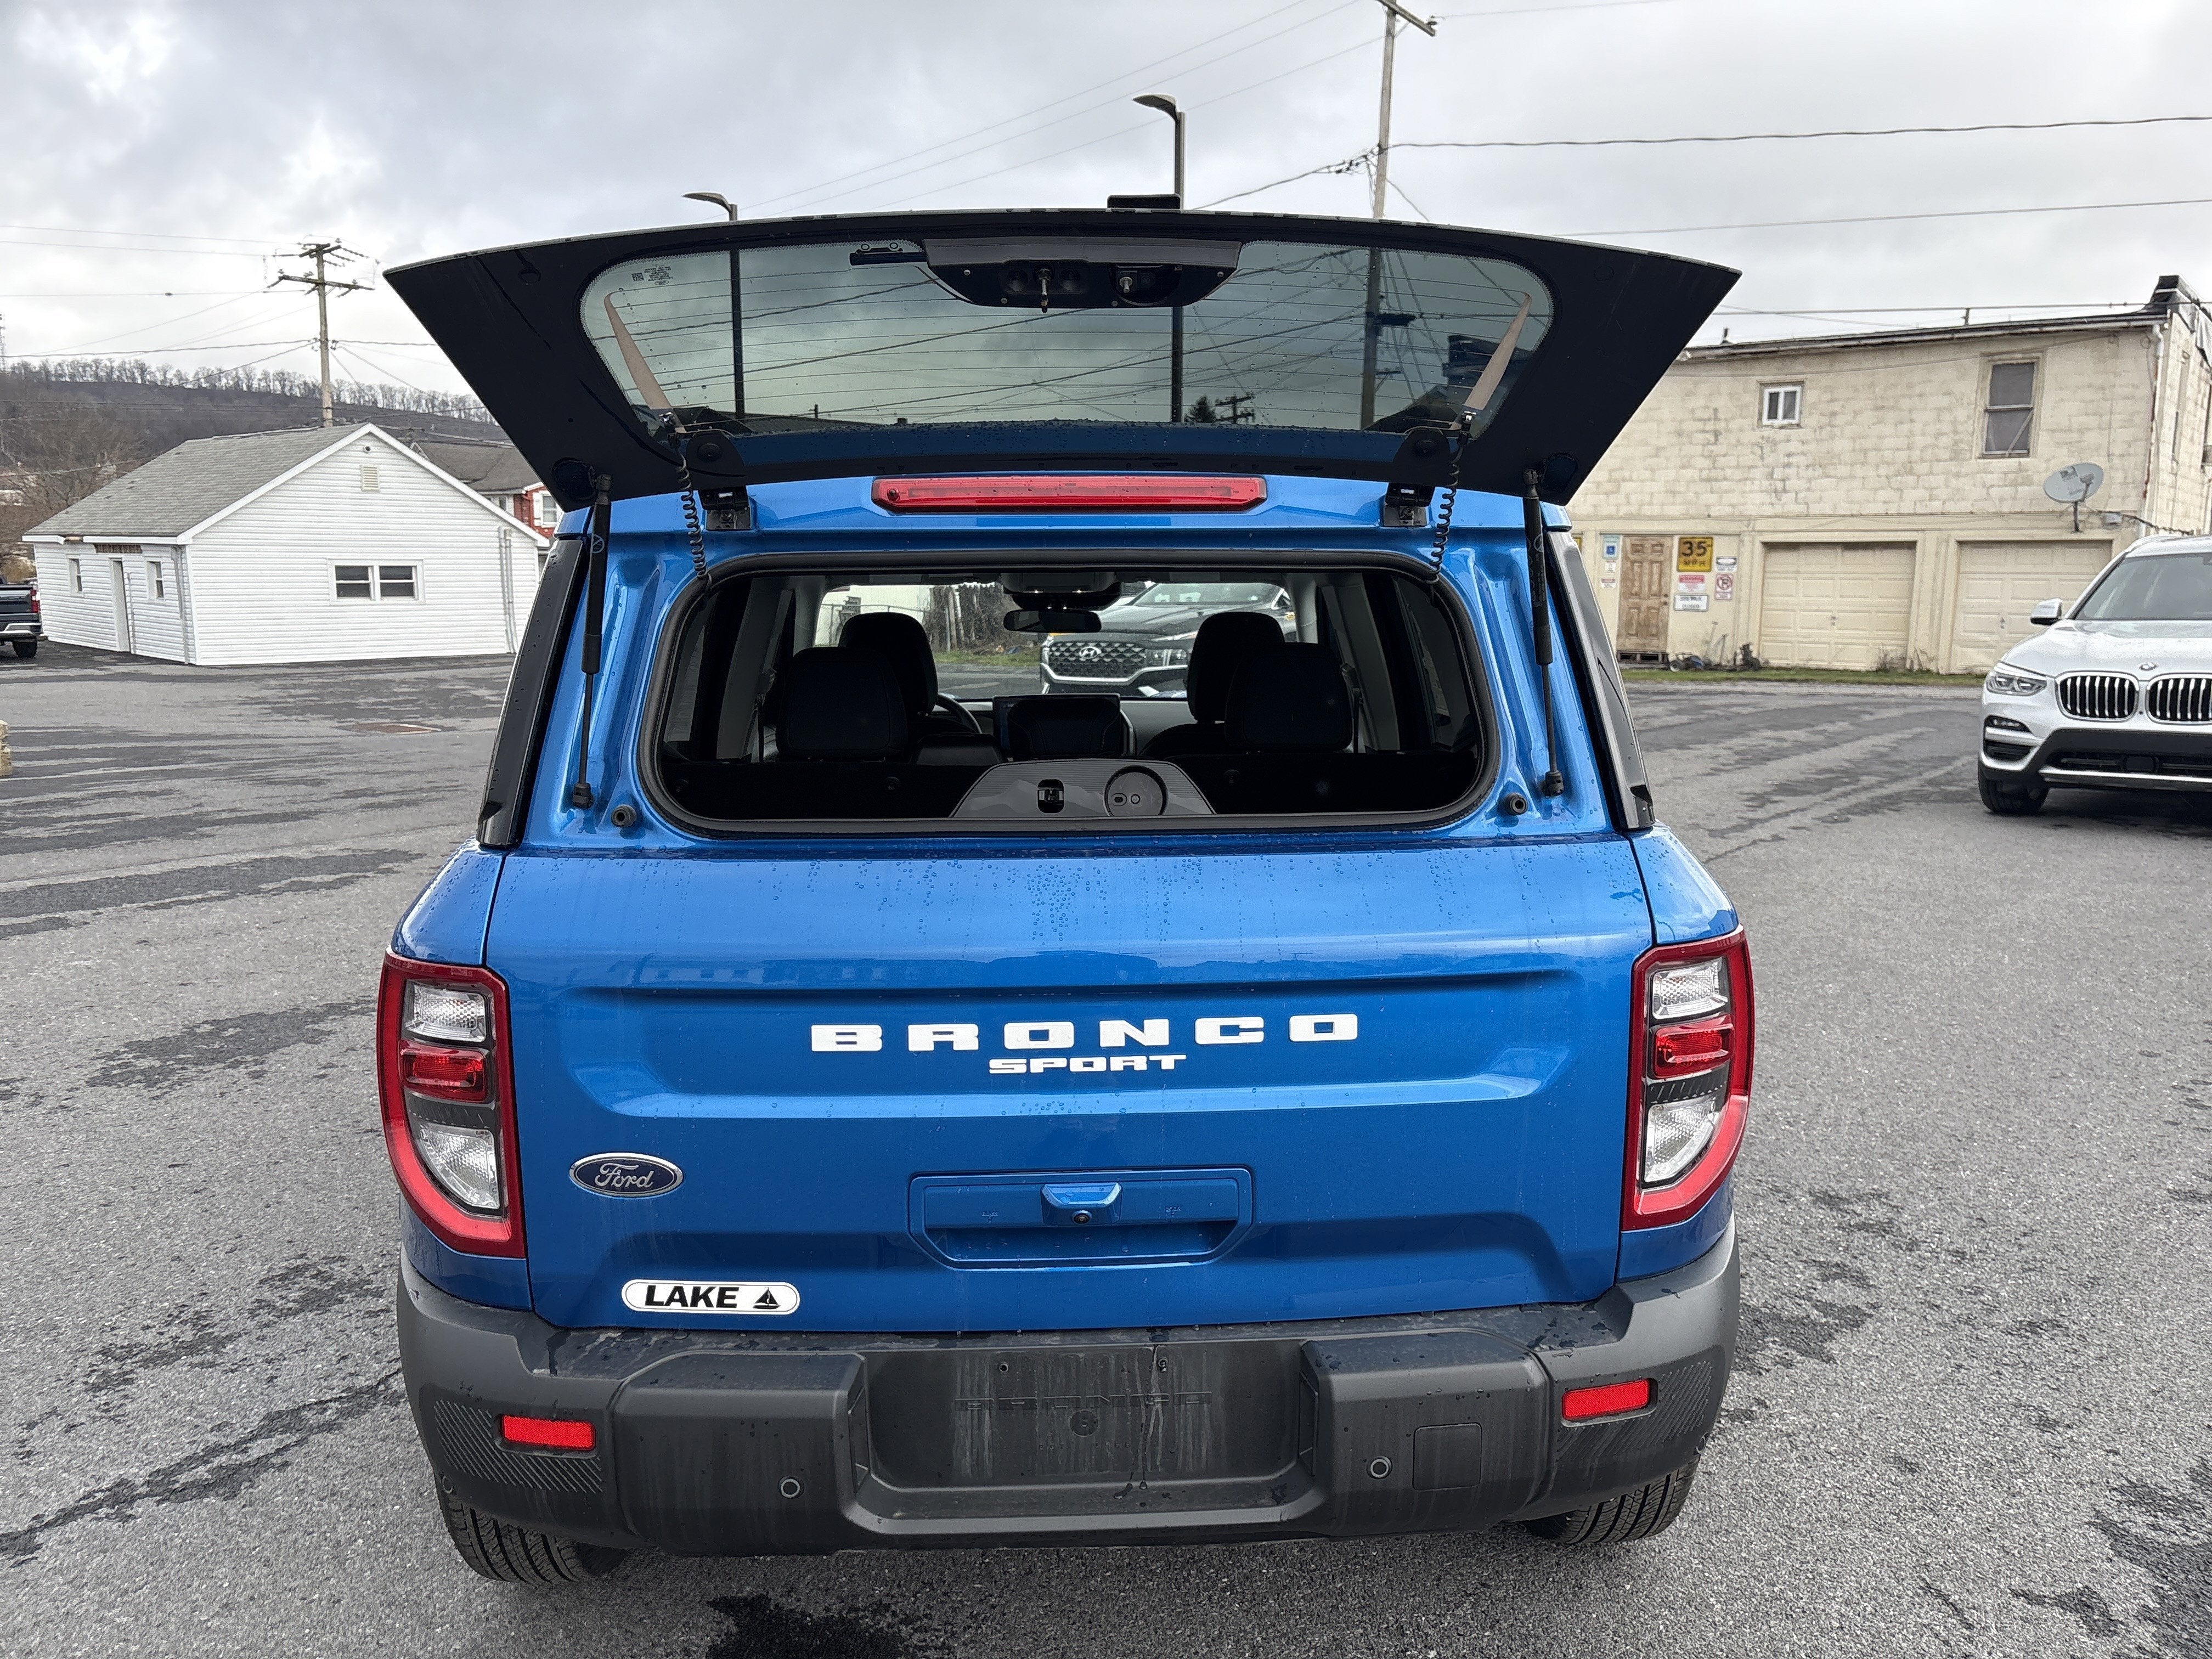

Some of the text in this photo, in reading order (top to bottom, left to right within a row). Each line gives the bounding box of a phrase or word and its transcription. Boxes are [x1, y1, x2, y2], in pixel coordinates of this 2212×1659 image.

[1682, 541, 1707, 557] 35
[810, 1013, 1358, 1052] BRONCO
[989, 1054, 1187, 1075] SPORT
[594, 1163, 654, 1189] Ford
[645, 1284, 740, 1308] LAKE
[955, 1391, 1212, 1411] BRONCO
